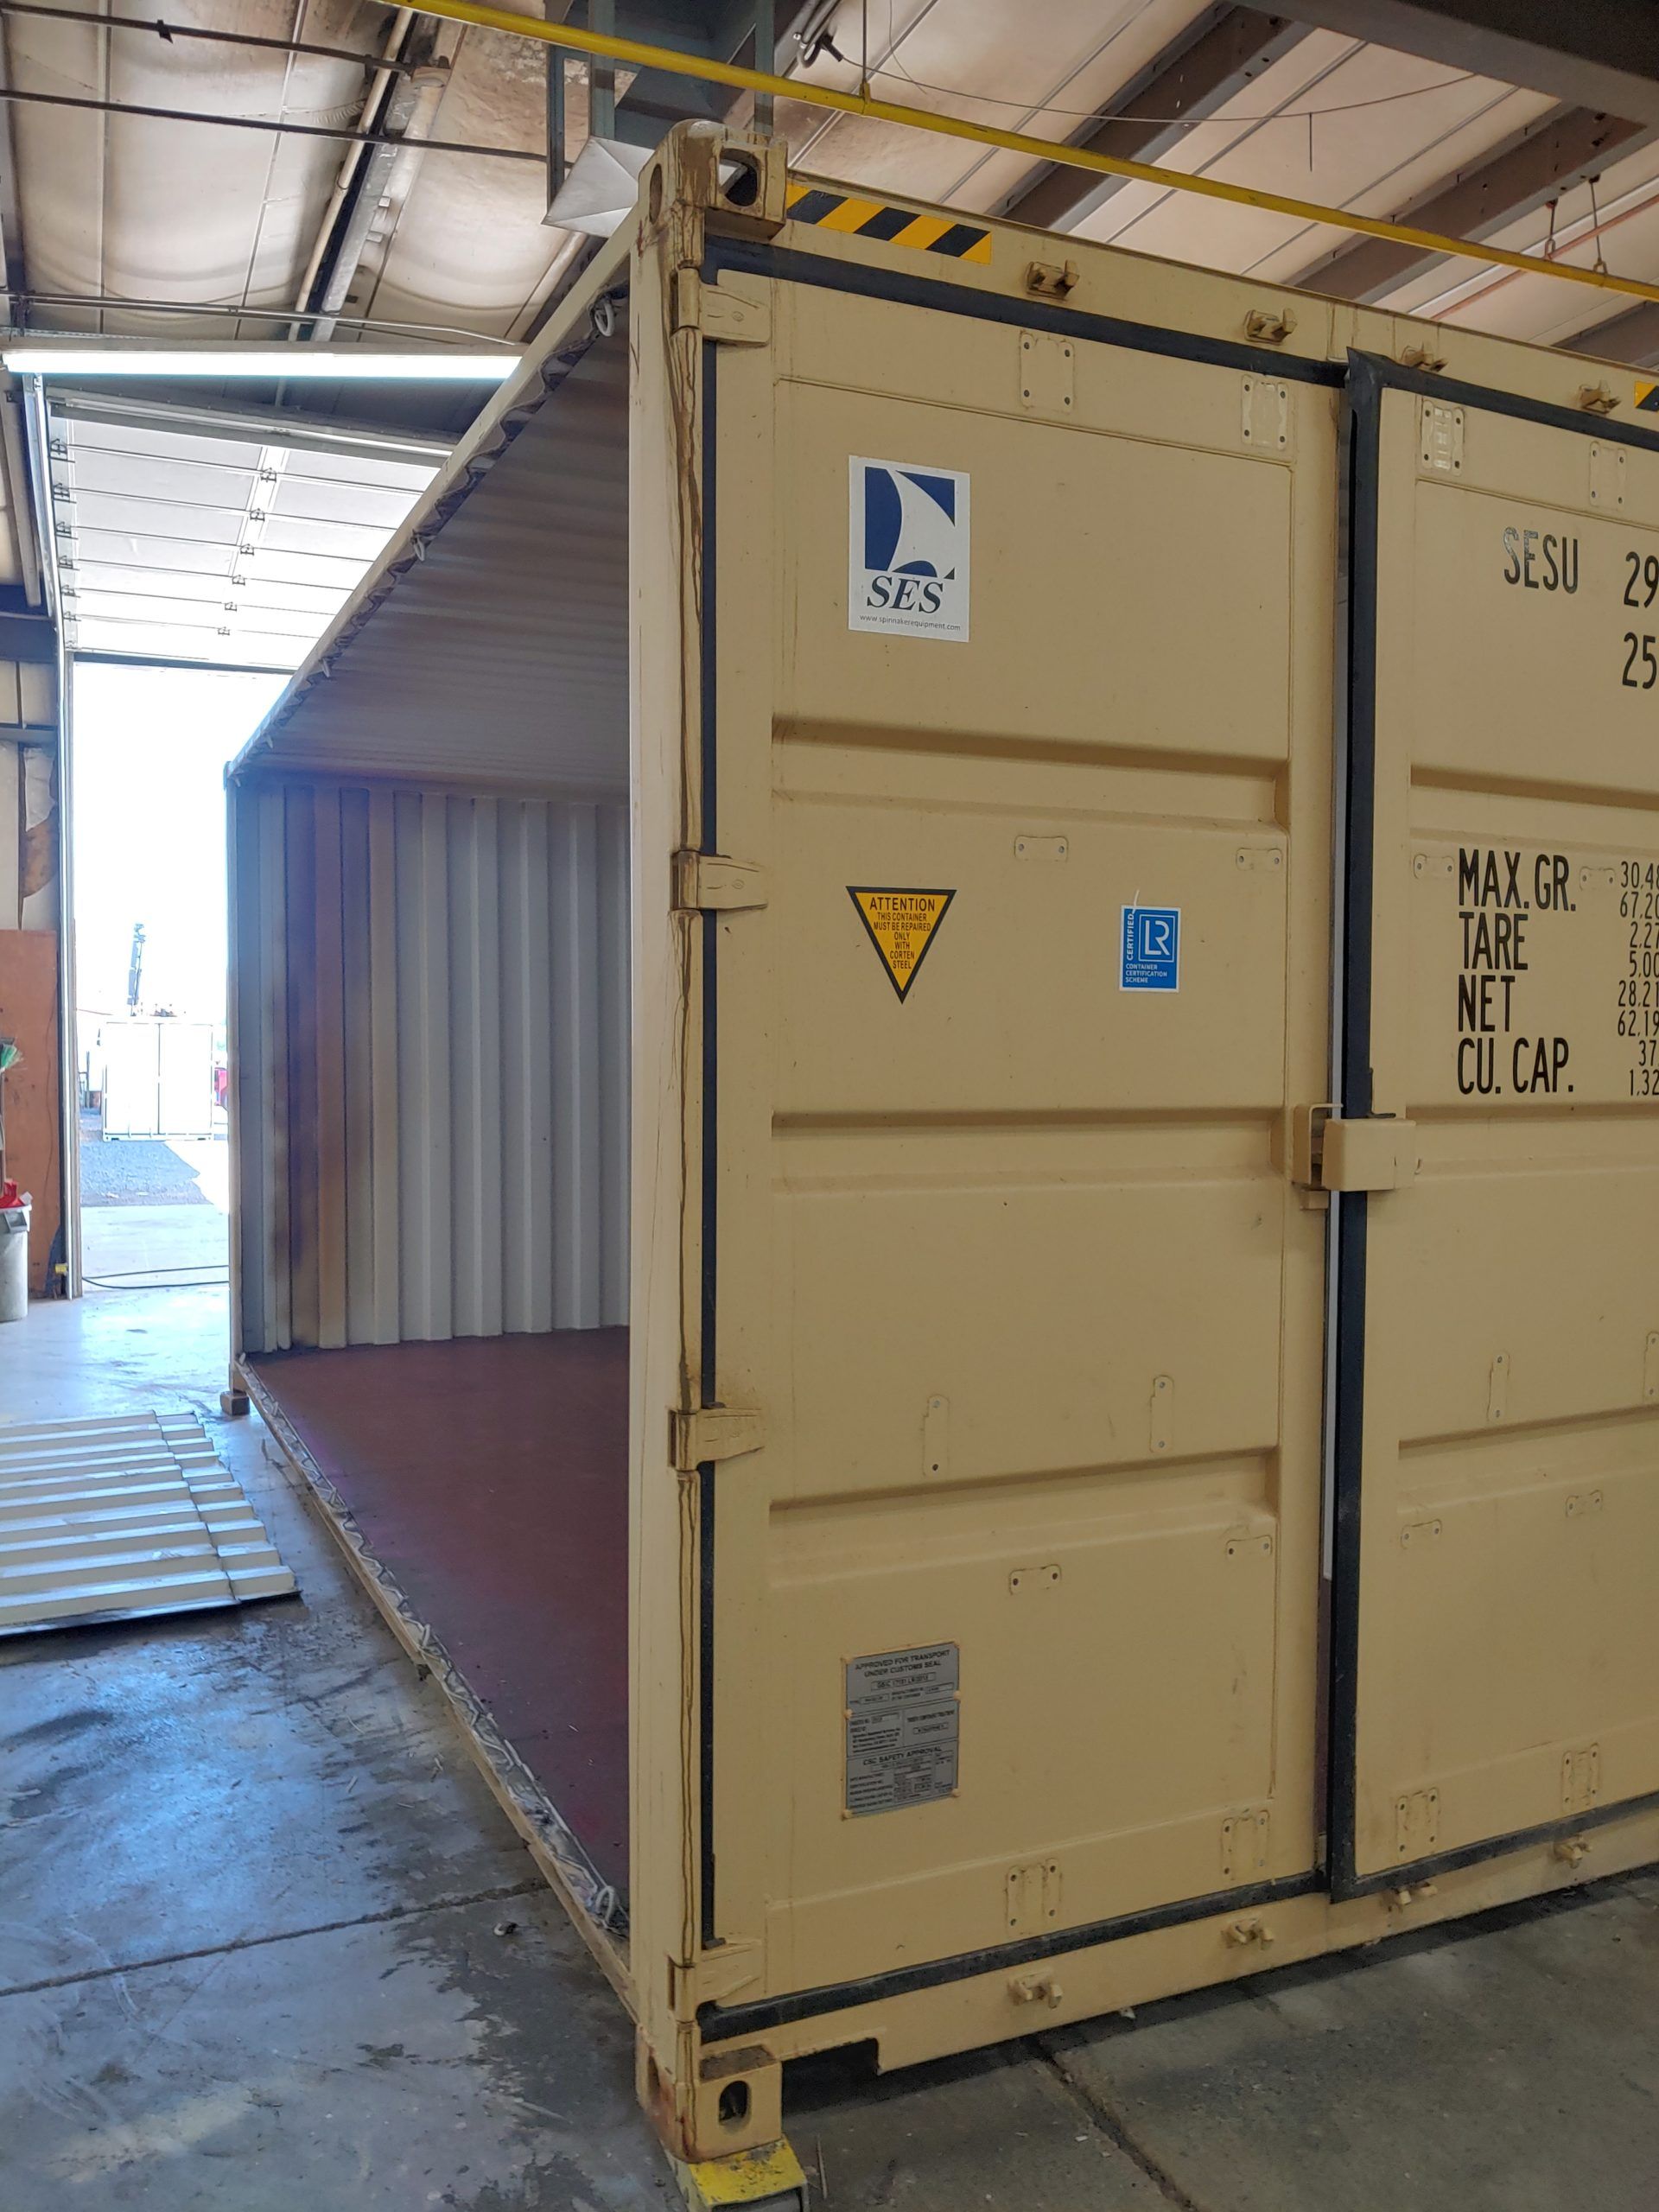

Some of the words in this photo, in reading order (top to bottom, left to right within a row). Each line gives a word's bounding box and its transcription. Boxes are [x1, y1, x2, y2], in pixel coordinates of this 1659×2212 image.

[1503, 526, 1578, 594] SESU
[1624, 550, 1659, 608] 29
[867, 575, 944, 614] SES
[859, 614, 961, 631] www.spinnakerequipment.com
[1622, 632, 1657, 690] 25
[869, 897, 935, 912] ATTENTION
[874, 921, 891, 931] MUST
[892, 922, 900, 931] BE
[901, 922, 931, 931] REPAIRED
[877, 912, 892, 921] THIS
[892, 912, 927, 922] CONTAINER
[894, 931, 910, 941] ONLY
[1145, 920, 1170, 955] LR
[1459, 912, 1528, 970] TARE
[895, 941, 910, 950] WITH
[890, 950, 915, 960] CORTEN
[893, 960, 912, 969] STEEL
[1458, 974, 1516, 1033] NET
[1458, 1037, 1502, 1095] CU.
[1512, 1037, 1574, 1094] CAP.
[855, 1658, 893, 1669] APPROVED
[894, 1656, 909, 1665] FOR
[911, 1649, 950, 1662] TRANSPORT
[864, 1668, 889, 1677] UNDER
[890, 1662, 923, 1674] CUSTOMS
[924, 1659, 941, 1668] SEAL
[879, 1751, 904, 1763] SAFETY
[906, 1745, 942, 1758] APPROVAL
